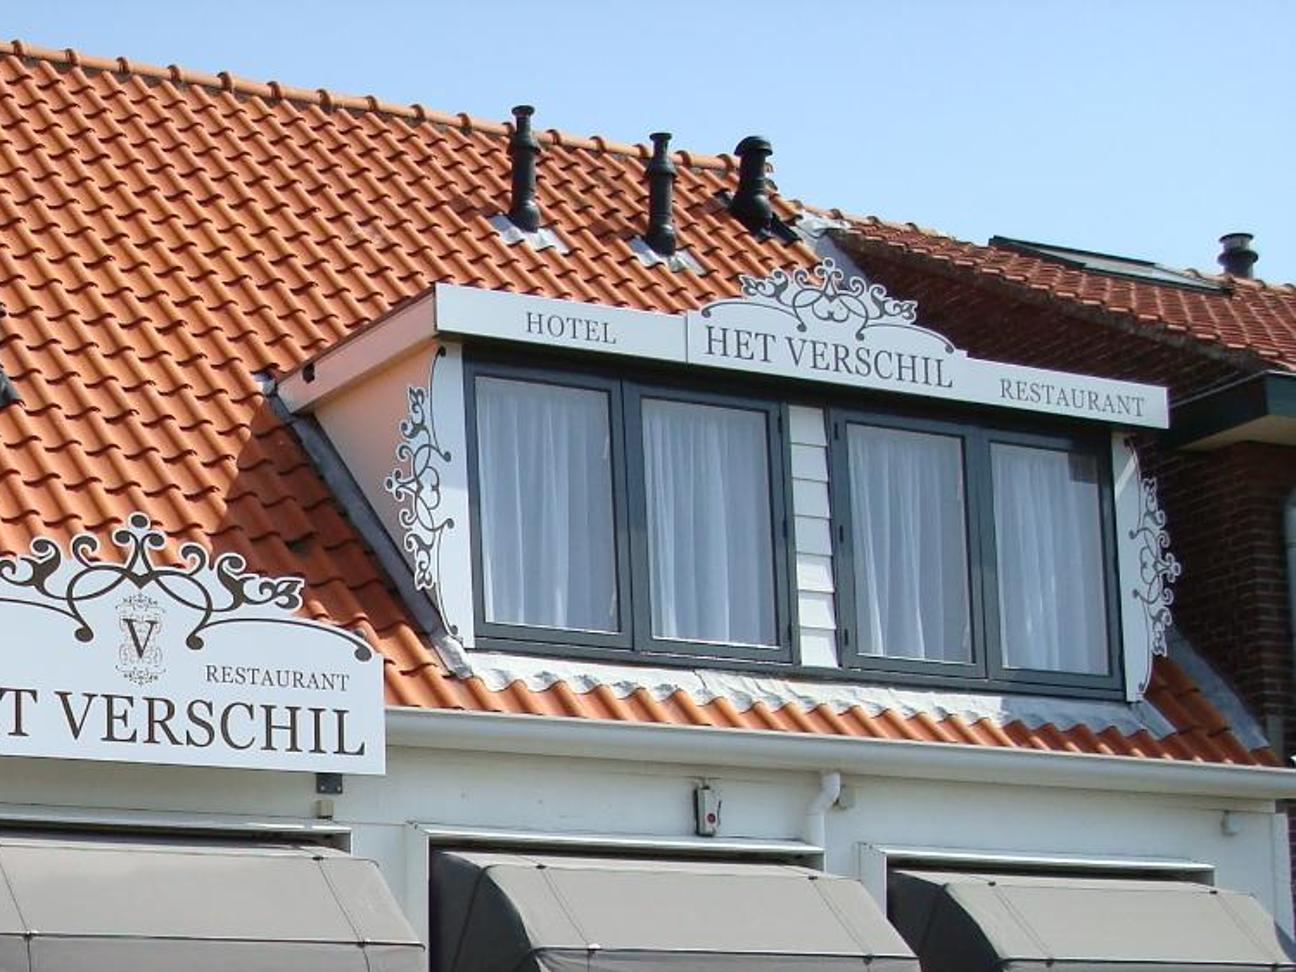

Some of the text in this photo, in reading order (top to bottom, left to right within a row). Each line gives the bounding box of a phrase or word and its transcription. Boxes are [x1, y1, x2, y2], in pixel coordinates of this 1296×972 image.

[526, 311, 617, 344] HOTEL
[705, 325, 953, 388] HET VERSCHIL
[999, 378, 1146, 417] RESTAURANT
[123, 618, 158, 659] V
[205, 664, 350, 691] RESTAURANT
[54, 691, 366, 756] VERSCHIL
